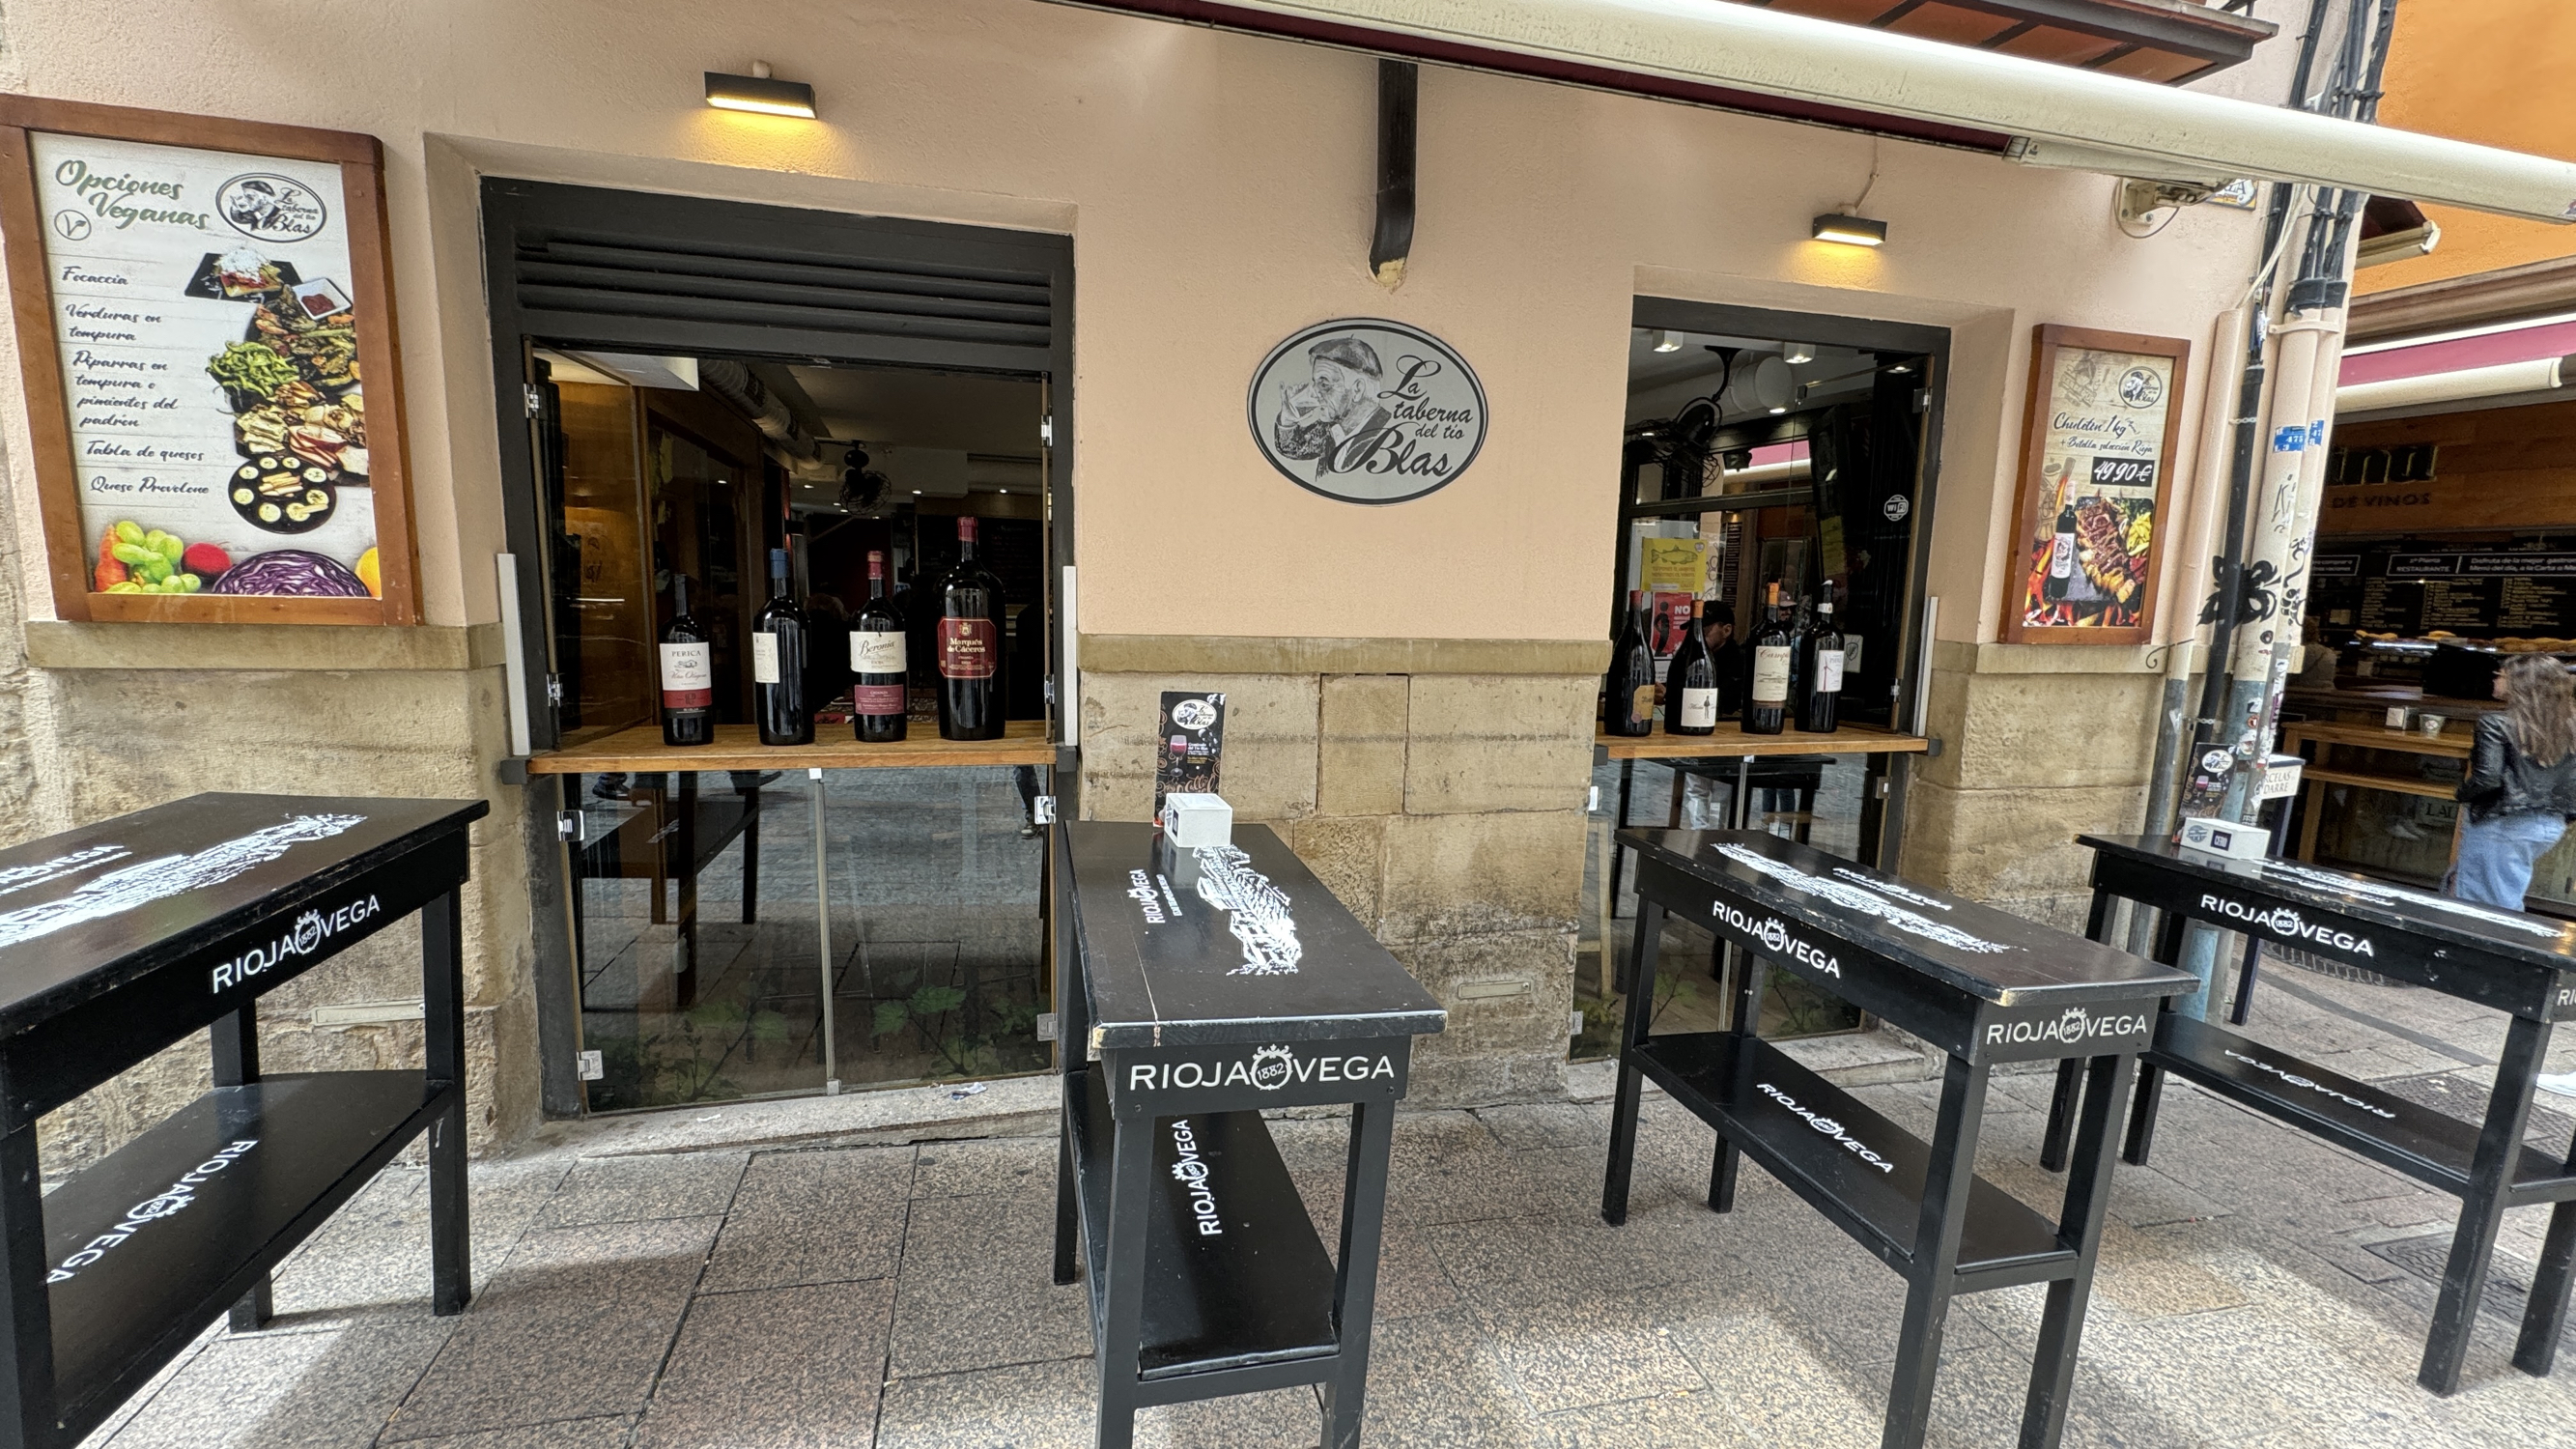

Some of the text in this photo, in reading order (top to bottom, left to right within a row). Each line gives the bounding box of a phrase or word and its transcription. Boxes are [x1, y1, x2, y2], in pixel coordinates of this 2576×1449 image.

[55, 159, 184, 200] Opciones
[88, 191, 211, 230] Veganas
[266, 213, 313, 234] Blas
[61, 266, 129, 286] Focaccia
[65, 302, 162, 324] Verduras en
[69, 326, 137, 343] tempura
[72, 350, 169, 372] Piparras en
[74, 374, 143, 390] tempura
[1376, 354, 1442, 402] La
[76, 395, 179, 410] pimientos del
[1393, 397, 1473, 425] taberna
[1415, 423, 1438, 439] del
[2104, 414, 2118, 433] 1
[2112, 420, 2127, 440] kg
[86, 440, 205, 462] Tabla de quesos
[1327, 421, 1453, 477] Blas
[2067, 436, 2097, 449] Botella
[2131, 440, 2153, 457] Rioja
[90, 475, 211, 495] Queso Provolone
[2332, 492, 2431, 508] DE VINOS
[1674, 605, 1691, 615] NO
[860, 639, 895, 656] Beronia
[949, 637, 983, 646] Marqués
[954, 644, 986, 654] Cáceres
[2199, 894, 2375, 957] RIOJA 1882 VEGA
[212, 895, 381, 994] RIOJA 1882 VEGA
[1712, 899, 1841, 980] RIOJA 1882 VEGA
[2557, 988, 2576, 1007] RI
[1986, 1019, 2058, 1045] RIOJA
[2084, 1014, 2147, 1038] VEGA
[1130, 1055, 1396, 1092] RIOJA 1882 VEGA
[1756, 1082, 1816, 1122] RIOJA
[1833, 1132, 1895, 1175] VEGA
[1171, 1119, 1201, 1164] VEGA
[156, 1140, 260, 1199] RIOJA
[1187, 1175, 1223, 1236] RIOJA
[45, 1217, 154, 1285] VEGA
